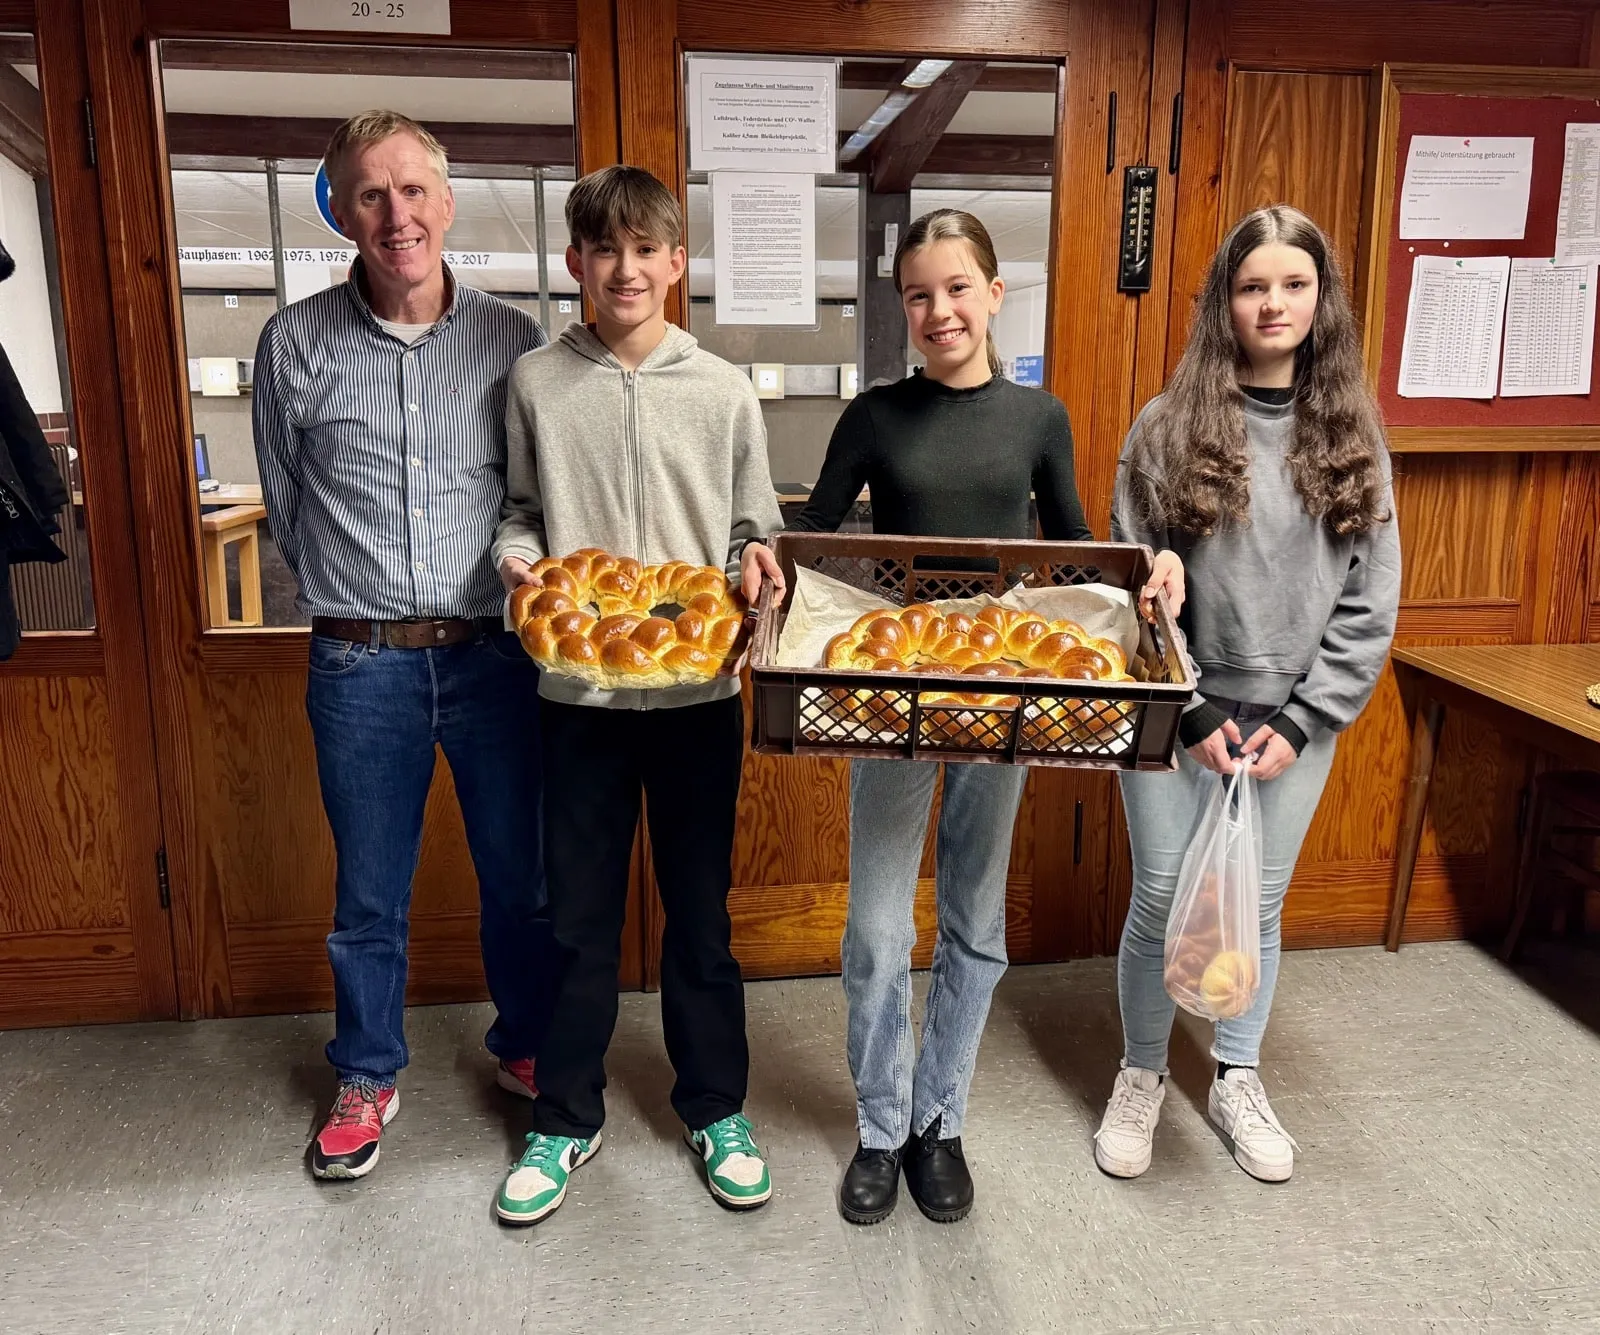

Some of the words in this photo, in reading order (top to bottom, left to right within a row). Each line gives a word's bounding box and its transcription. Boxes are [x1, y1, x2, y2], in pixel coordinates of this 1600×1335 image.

[351, 2, 370, 17] 20
[386, 3, 405, 18] 25
[1415, 150, 1440, 159] Mithilfe/
[1440, 151, 1484, 160] Unterstützung
[1484, 151, 1516, 160] gebraucht
[178, 249, 241, 263] Bauphasen:
[284, 250, 315, 262] 1975,
[320, 251, 352, 263] 1978,
[462, 254, 490, 265] 2017
[226, 297, 238, 306] 18
[560, 303, 571, 312] 21
[844, 307, 853, 315] 24
